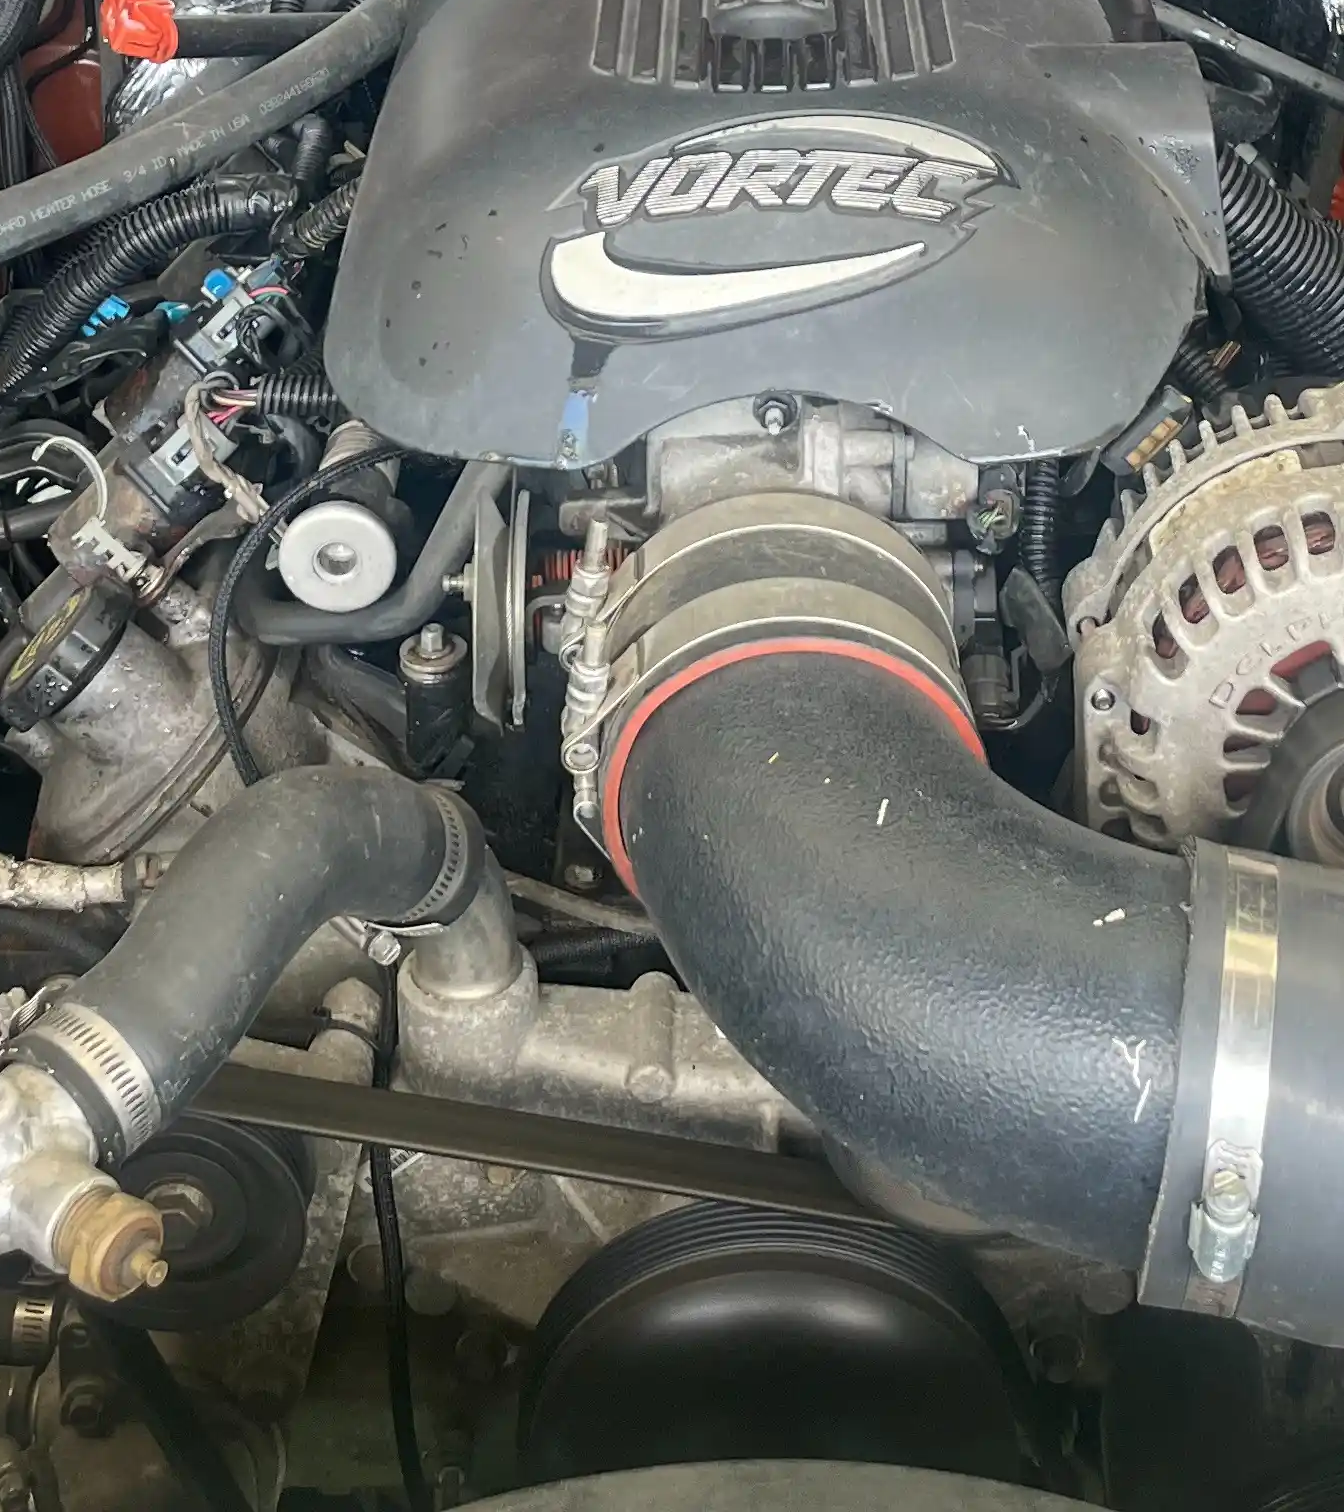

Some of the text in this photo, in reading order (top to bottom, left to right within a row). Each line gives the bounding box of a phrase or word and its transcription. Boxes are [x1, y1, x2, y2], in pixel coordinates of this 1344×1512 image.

[30, 194, 77, 223] HEATER
[81, 179, 113, 202] HOSE
[152, 155, 167, 171] ID
[176, 138, 205, 158] MADE
[228, 114, 251, 133] USA
[578, 148, 979, 226] VORTEC
